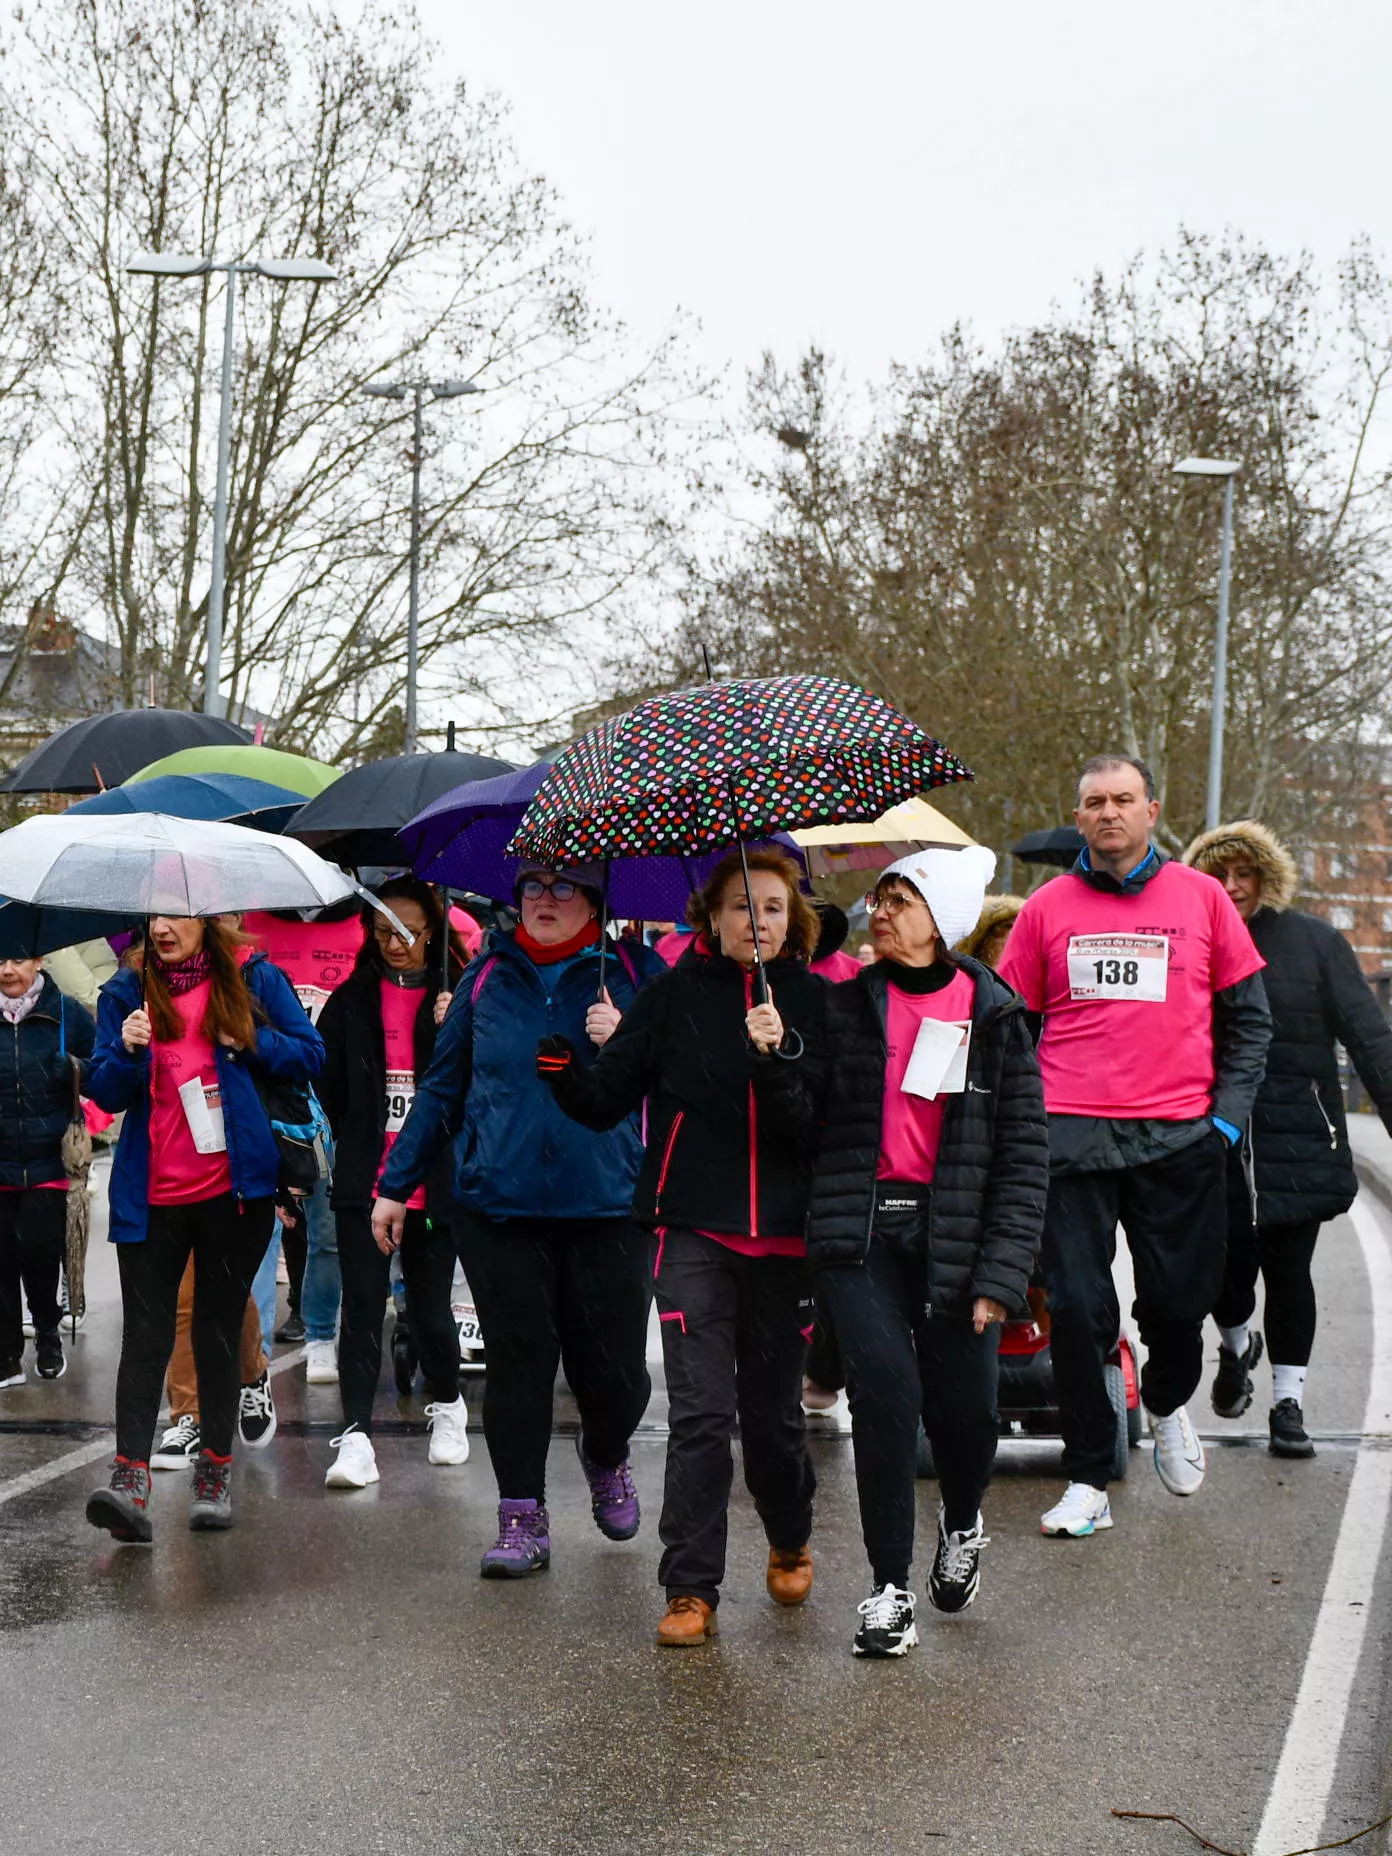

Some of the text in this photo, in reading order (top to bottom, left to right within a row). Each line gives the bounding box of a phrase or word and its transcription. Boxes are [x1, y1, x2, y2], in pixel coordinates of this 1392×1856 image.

[1078, 938, 1112, 947] Carrera
[1113, 938, 1124, 946] de
[1125, 938, 1133, 946] la
[1092, 960, 1139, 986] 138
